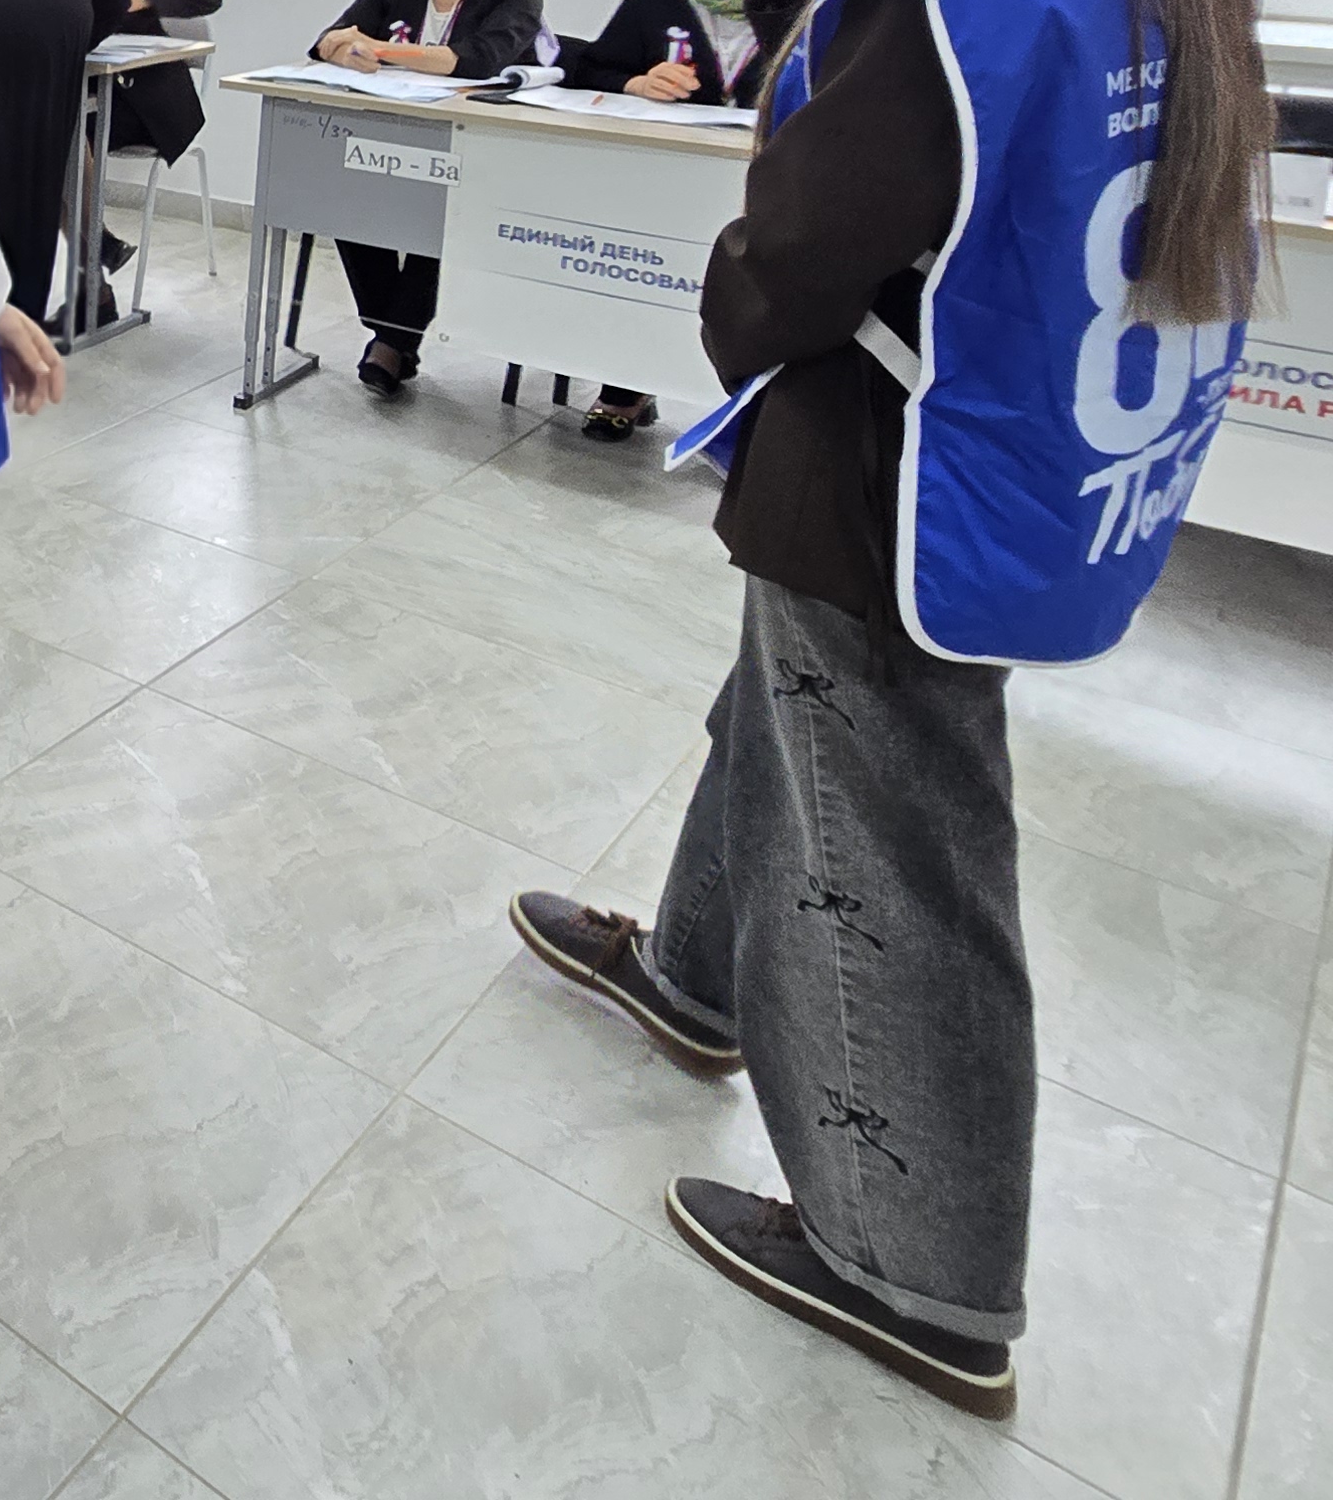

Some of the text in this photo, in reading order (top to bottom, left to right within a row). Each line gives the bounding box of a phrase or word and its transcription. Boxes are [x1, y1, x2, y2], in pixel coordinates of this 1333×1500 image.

[1107, 101, 1161, 139] ВОЛ
[346, 144, 402, 175] Амр
[429, 157, 459, 182] Ба
[497, 223, 664, 266] ЕДИНЫЙ ДЕНЬ
[560, 255, 704, 294] ГОЛОСОВАН
[1233, 358, 1333, 390] ОЛОС
[1228, 384, 1306, 414] ИЛА
